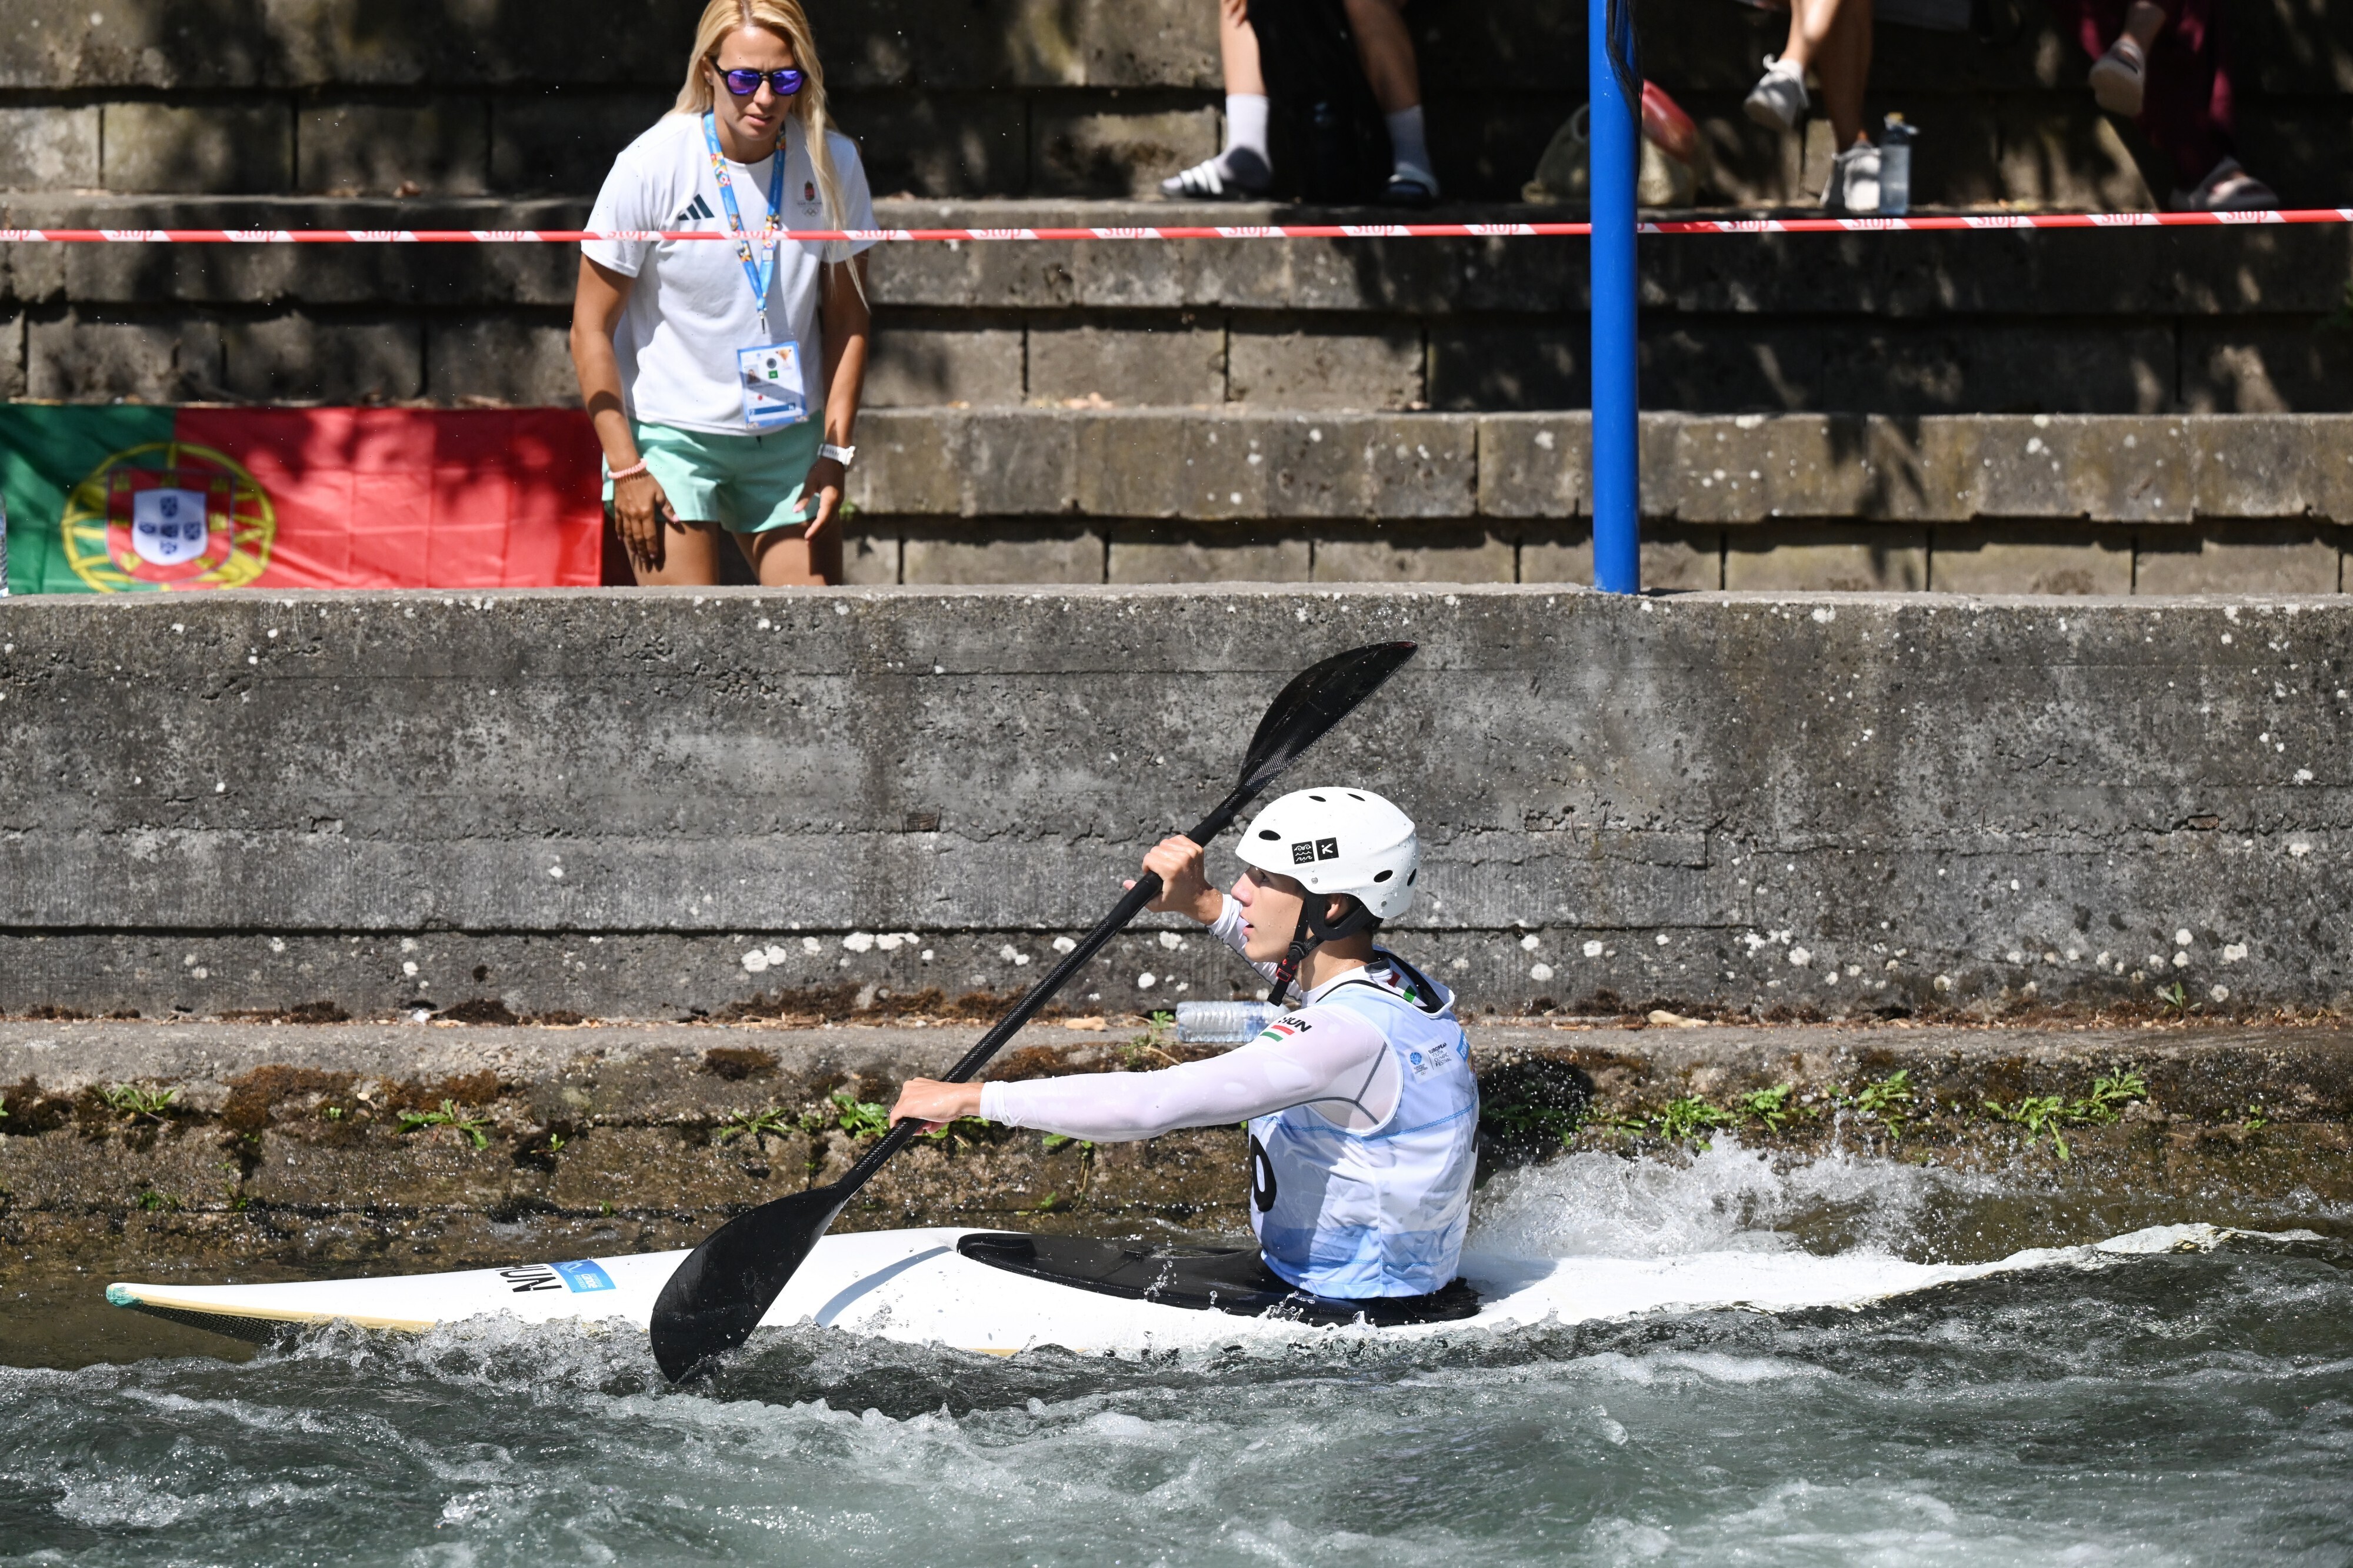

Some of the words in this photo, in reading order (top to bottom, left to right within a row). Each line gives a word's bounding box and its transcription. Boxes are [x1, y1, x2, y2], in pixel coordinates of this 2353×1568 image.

[1, 230, 31, 241] top
[112, 231, 154, 242] Stop
[236, 231, 277, 242] Stop
[359, 231, 401, 242] Stop
[484, 231, 525, 242] Stop
[607, 231, 649, 240] Stop
[731, 231, 772, 240] Stop
[855, 231, 896, 240] Stop
[979, 229, 1021, 239] Stop
[1104, 228, 1145, 239] Stop
[1228, 226, 1270, 237] Stop
[1353, 226, 1395, 236] Stop
[1478, 224, 1520, 235] Stop
[1727, 221, 1769, 232] Stop
[1851, 219, 1894, 229] Stop
[1976, 217, 2018, 228] Stop
[2101, 213, 2144, 225] Stop
[2225, 211, 2268, 223] Stop
[1428, 1042, 1447, 1054] EUROPEAN
[1434, 1052, 1449, 1062] OLYMPIC
[1435, 1057, 1452, 1067] FESTIVAL
